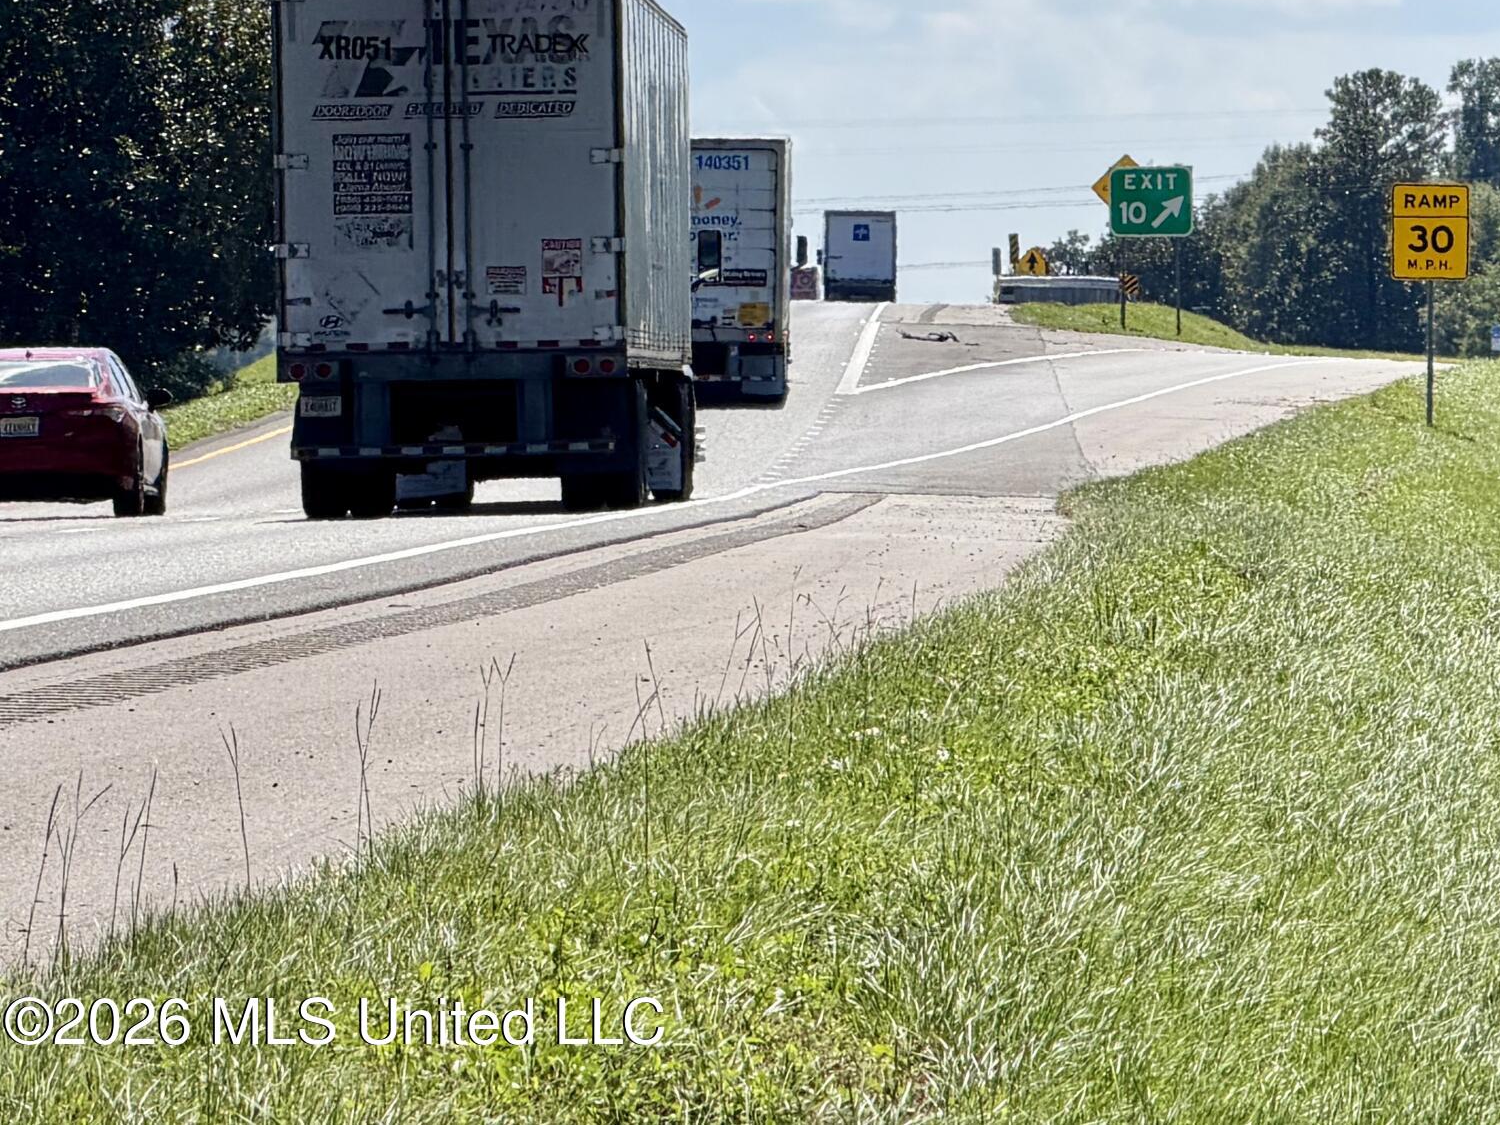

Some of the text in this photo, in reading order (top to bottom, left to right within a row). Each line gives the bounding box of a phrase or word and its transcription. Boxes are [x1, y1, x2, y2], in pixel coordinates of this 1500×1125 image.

[319, 36, 392, 60] XR051
[500, 102, 572, 115] DEDICATED
[695, 155, 750, 171] 140351
[1124, 173, 1177, 190] EXIT
[1404, 192, 1461, 209] RAMP
[1119, 201, 1147, 225] 10
[1408, 225, 1455, 253] 30
[1407, 259, 1453, 271] M.P.H.
